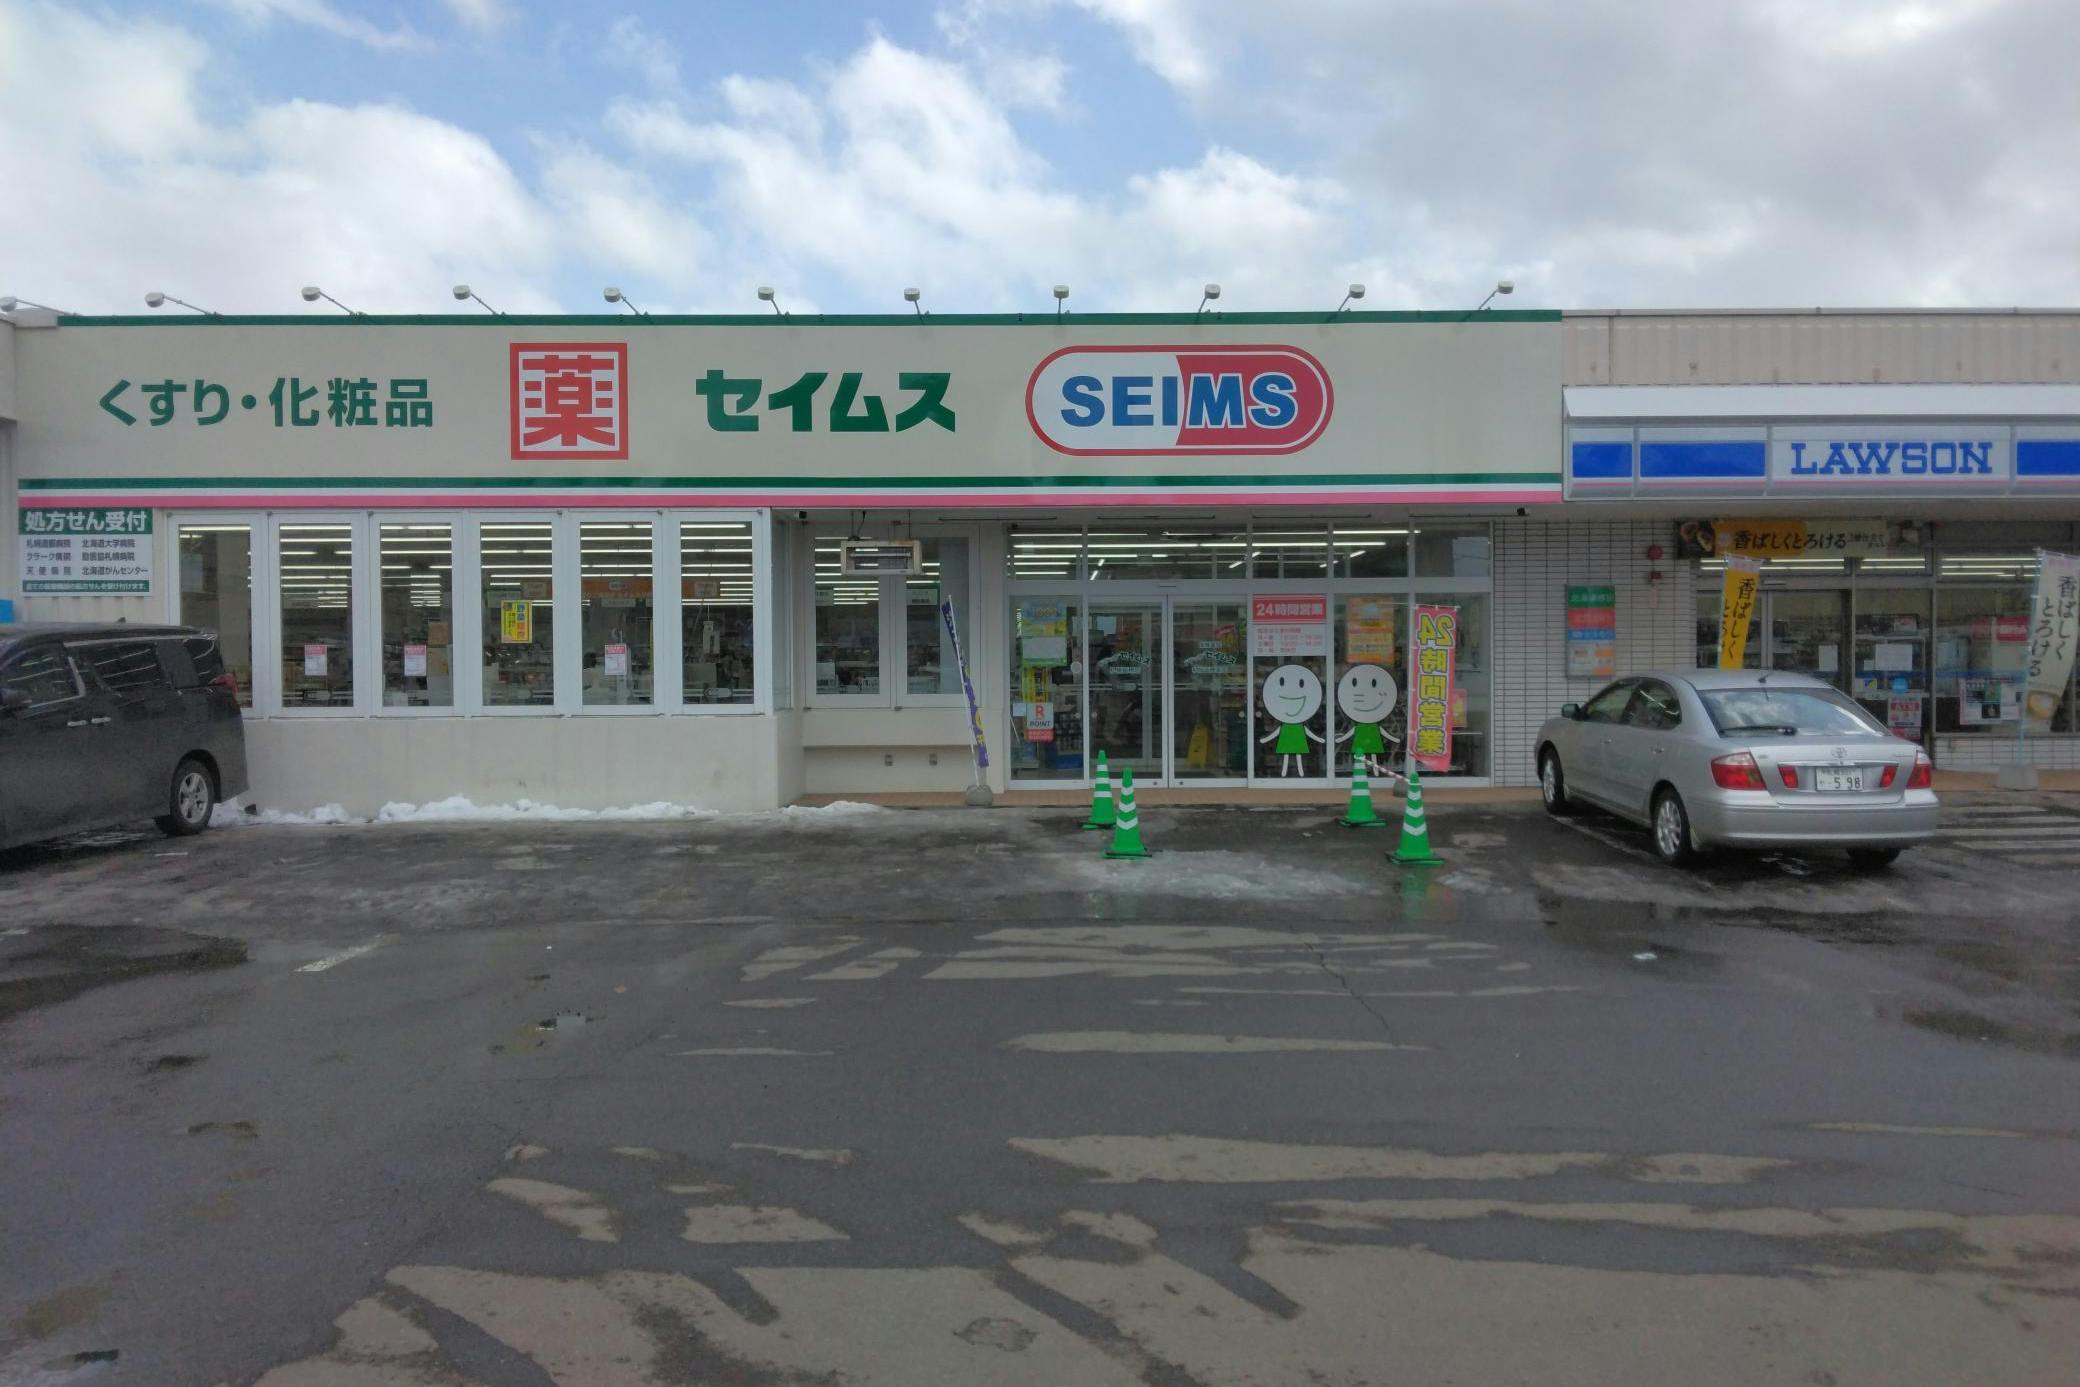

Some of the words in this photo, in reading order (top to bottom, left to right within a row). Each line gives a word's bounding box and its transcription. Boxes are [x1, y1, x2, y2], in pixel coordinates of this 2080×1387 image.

[100, 379, 433, 427] くすり・化粧品
[522, 355, 615, 446] 薬
[696, 369, 956, 432] セイムス
[1060, 371, 1298, 429] SEIMS
[1790, 441, 1993, 475] LAWSON
[25, 510, 147, 532] 処方せん受付
[1734, 529, 1847, 550] 香ばしくとろける
[2029, 597, 2054, 677] とろける
[2056, 575, 2078, 661] 香ばしく
[1029, 720, 1052, 728] POINT
